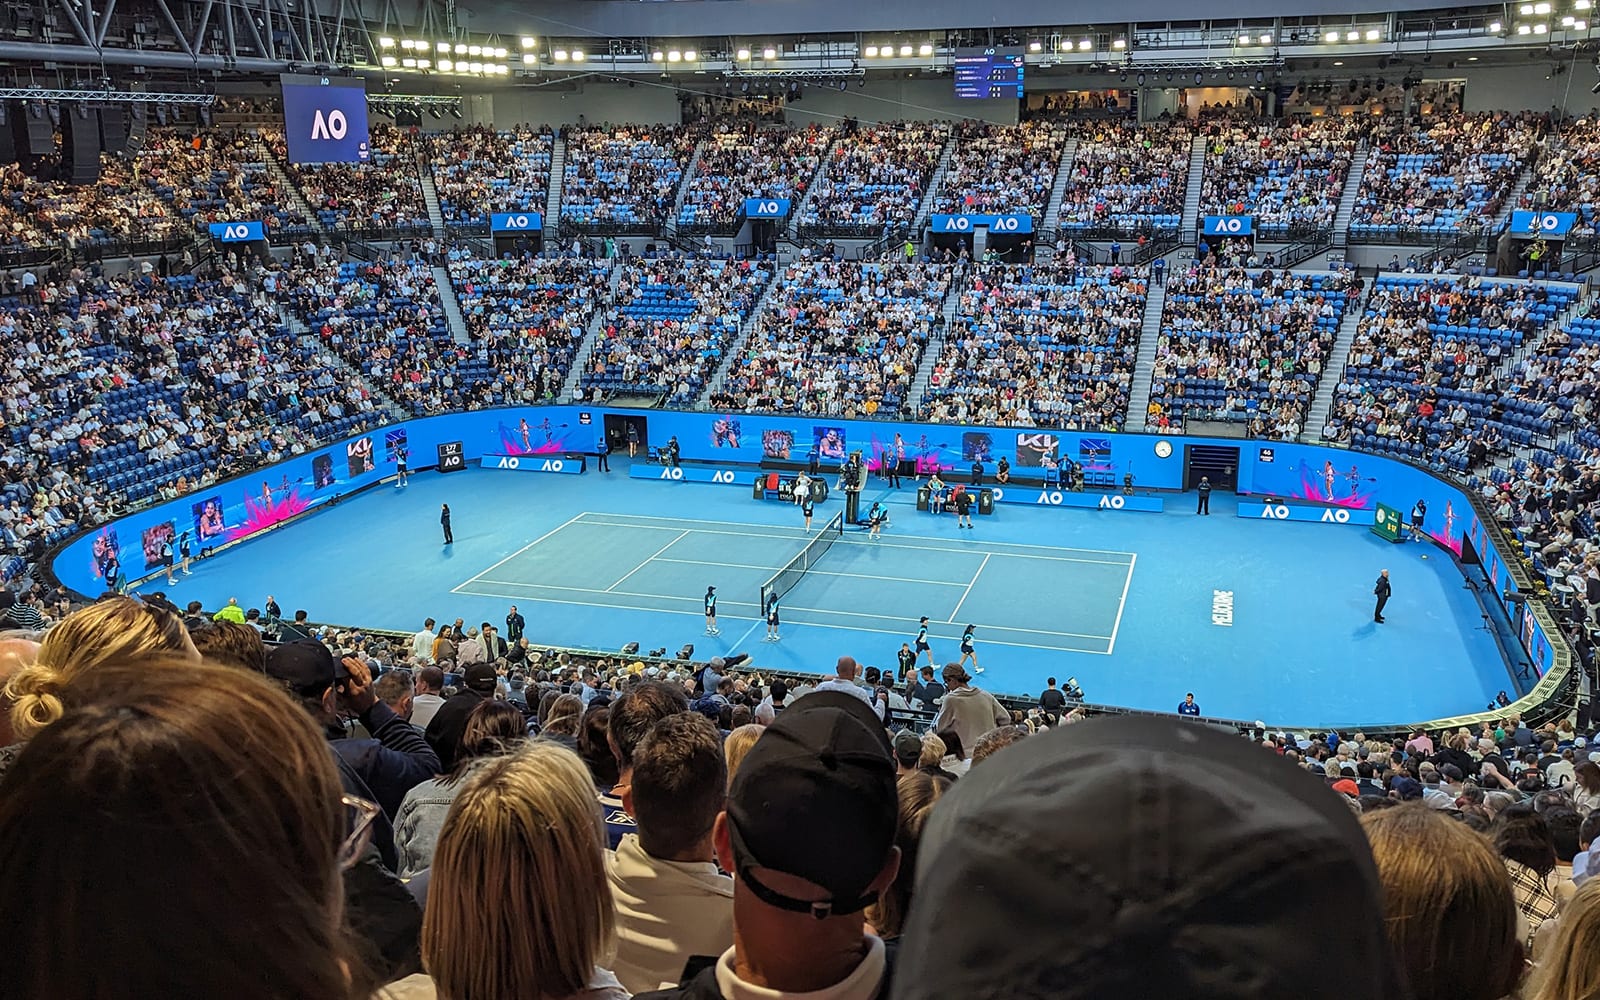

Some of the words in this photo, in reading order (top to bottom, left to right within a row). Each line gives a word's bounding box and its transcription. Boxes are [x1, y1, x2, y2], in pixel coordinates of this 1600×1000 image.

[311, 109, 347, 140] AO
[757, 201, 779, 214] AO
[505, 215, 529, 228] AO
[945, 217, 969, 230] AO
[994, 217, 1019, 231] AO
[1215, 218, 1242, 232] AO
[224, 225, 249, 239] AO
[444, 456, 460, 467] AO
[498, 457, 520, 470] AO
[541, 459, 564, 472] AO
[660, 467, 683, 480] AO
[711, 470, 735, 484] AO
[1037, 491, 1064, 505] AO
[1099, 494, 1125, 509] AO
[1261, 504, 1290, 520] AO
[1321, 508, 1350, 524] AO
